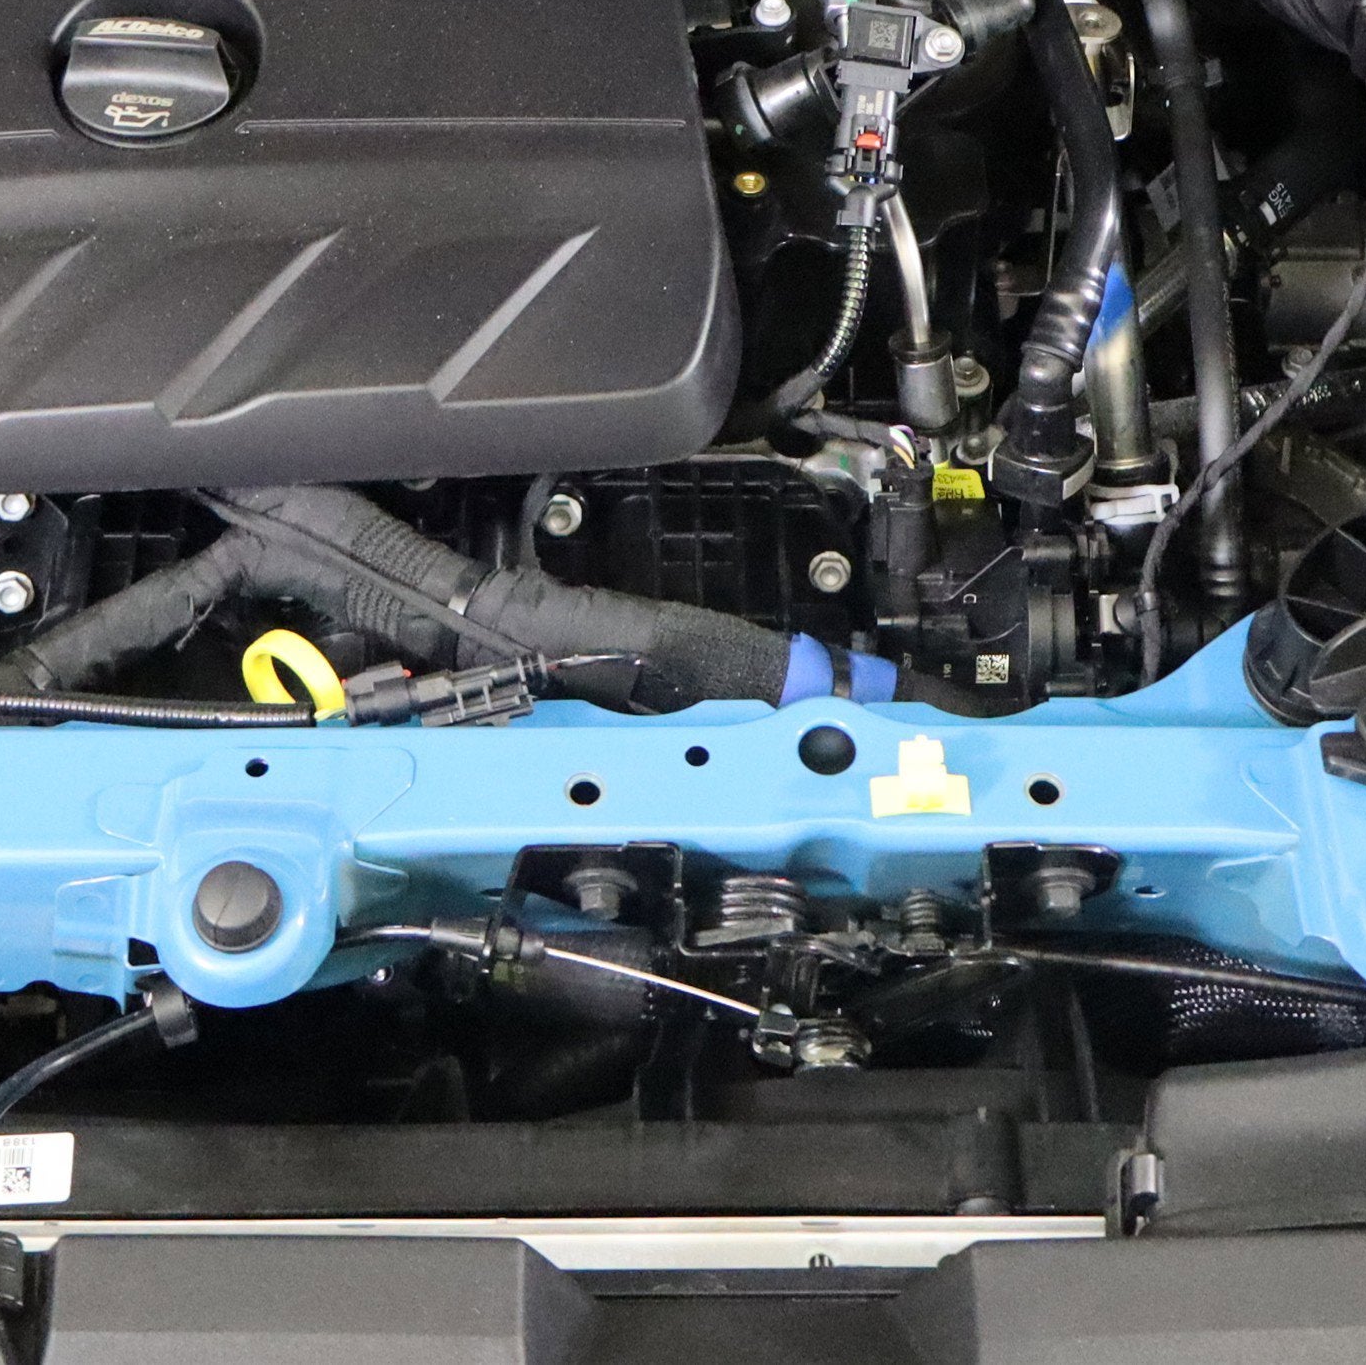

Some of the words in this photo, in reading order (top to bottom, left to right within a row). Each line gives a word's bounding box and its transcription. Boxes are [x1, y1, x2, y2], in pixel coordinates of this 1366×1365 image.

[88, 19, 205, 40] ACDelco
[111, 91, 176, 108] dexos
[1268, 189, 1289, 219] ENG
